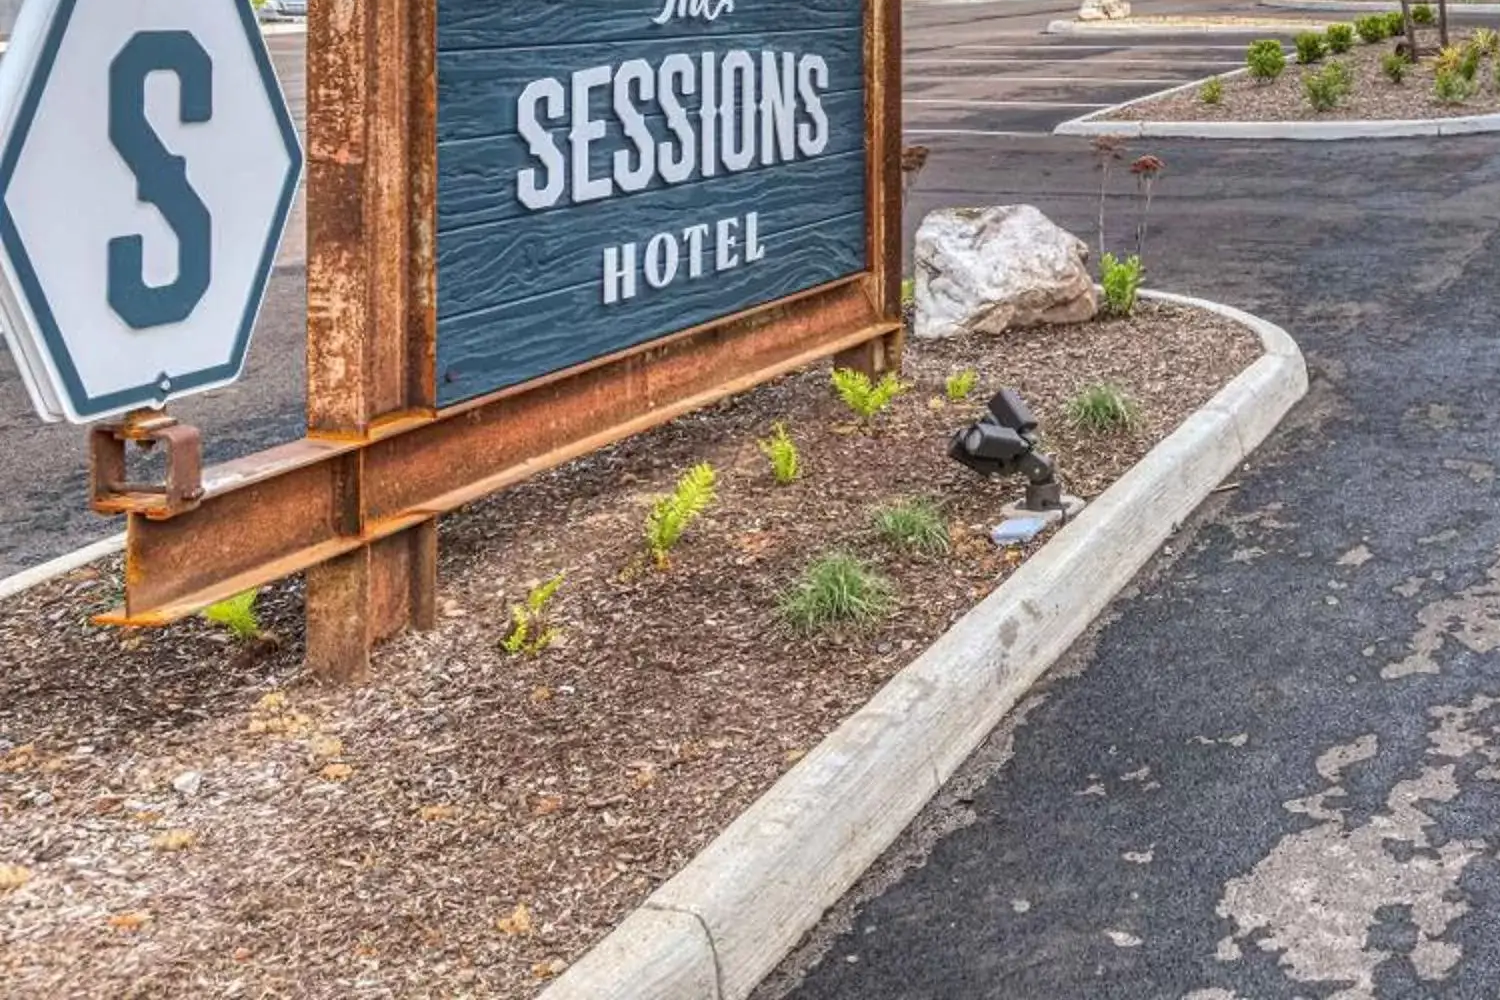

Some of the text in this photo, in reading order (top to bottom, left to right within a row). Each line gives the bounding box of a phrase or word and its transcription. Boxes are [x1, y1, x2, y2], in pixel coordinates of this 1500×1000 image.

[106, 29, 213, 330] S
[516, 49, 830, 210] SESSIONS
[603, 211, 766, 305] HOTEL
